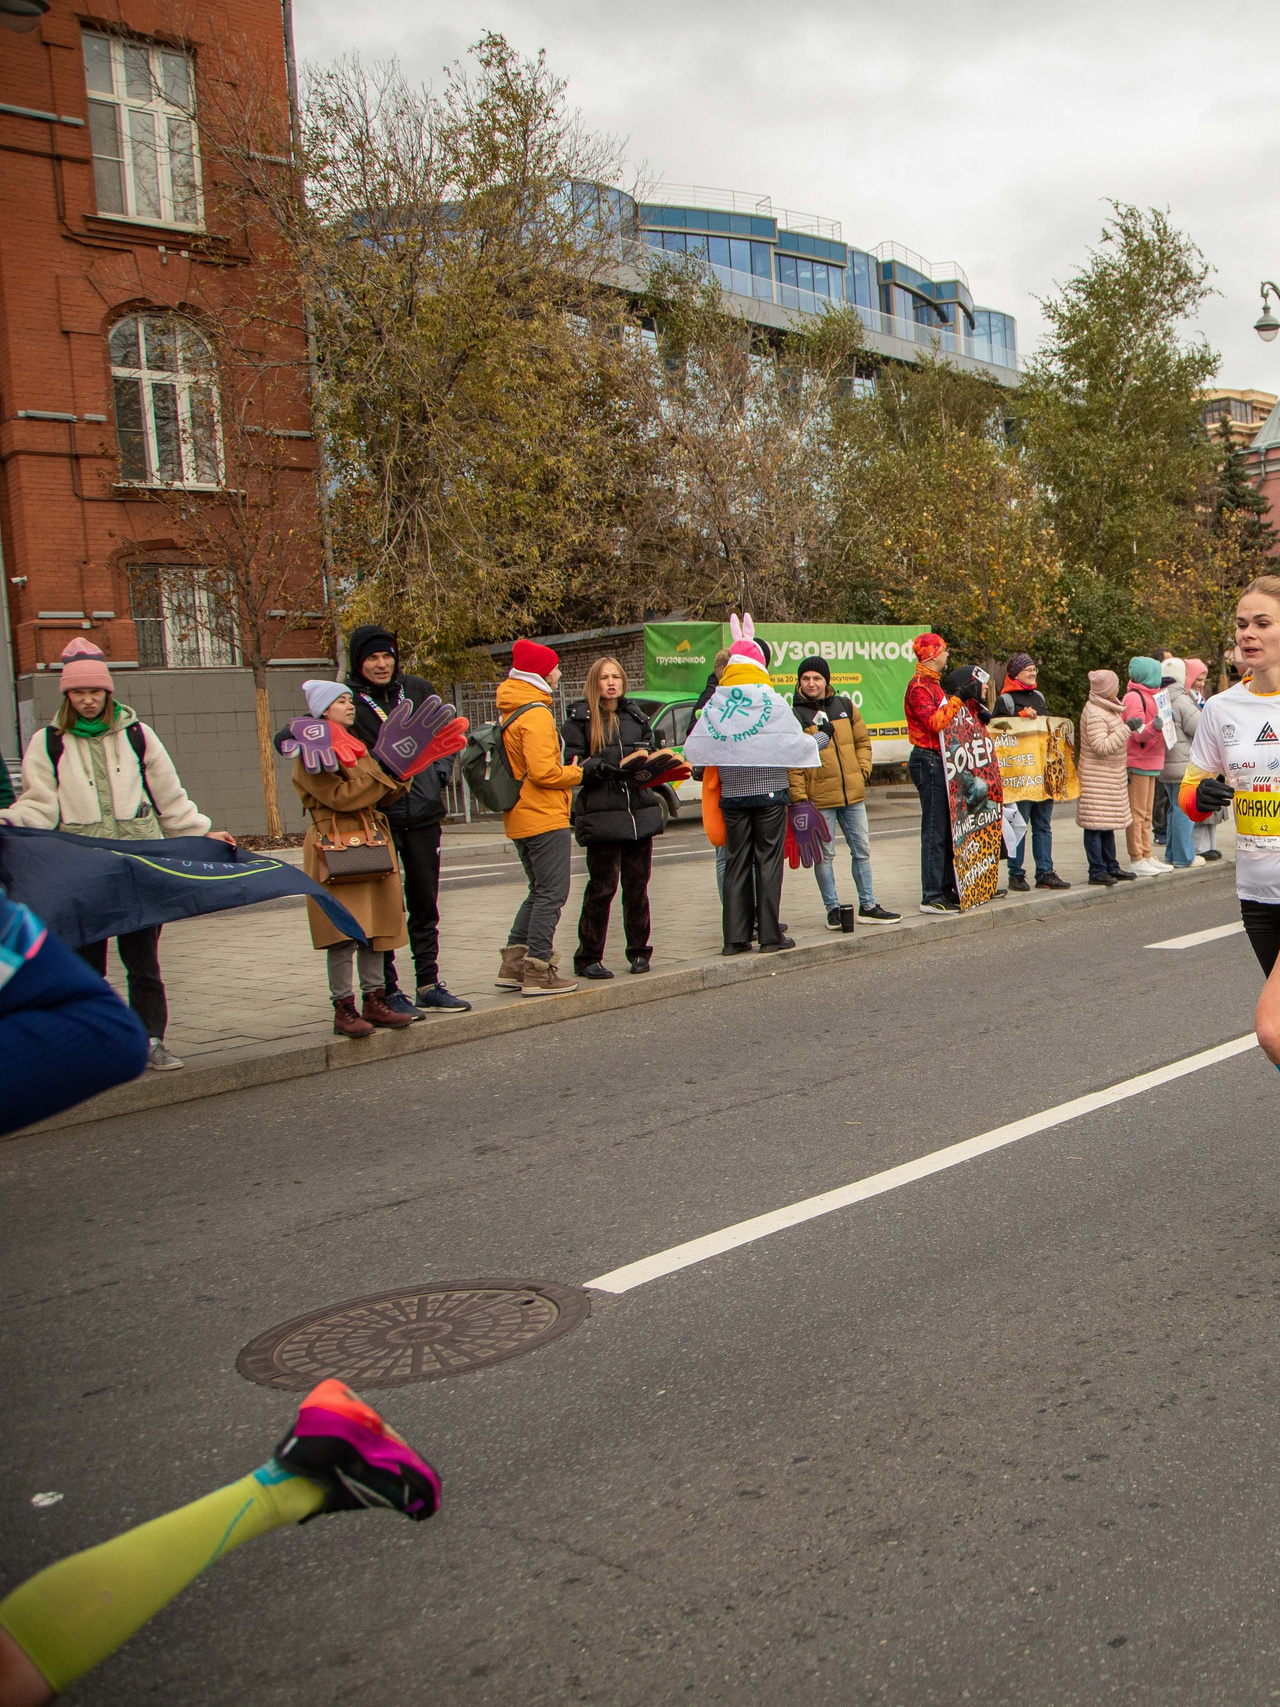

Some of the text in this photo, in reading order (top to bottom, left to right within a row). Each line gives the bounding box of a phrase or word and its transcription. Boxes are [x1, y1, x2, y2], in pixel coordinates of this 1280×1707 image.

[764, 638, 916, 667] узовичкоф
[656, 655, 706, 665] грузовичкоф
[994, 732, 1018, 749] АЙЫ
[1000, 774, 1044, 788] ОПАРДО
[977, 802, 1002, 827] СИЛ!
[1260, 824, 1269, 832] 42
[162, 857, 261, 871] UNNE
